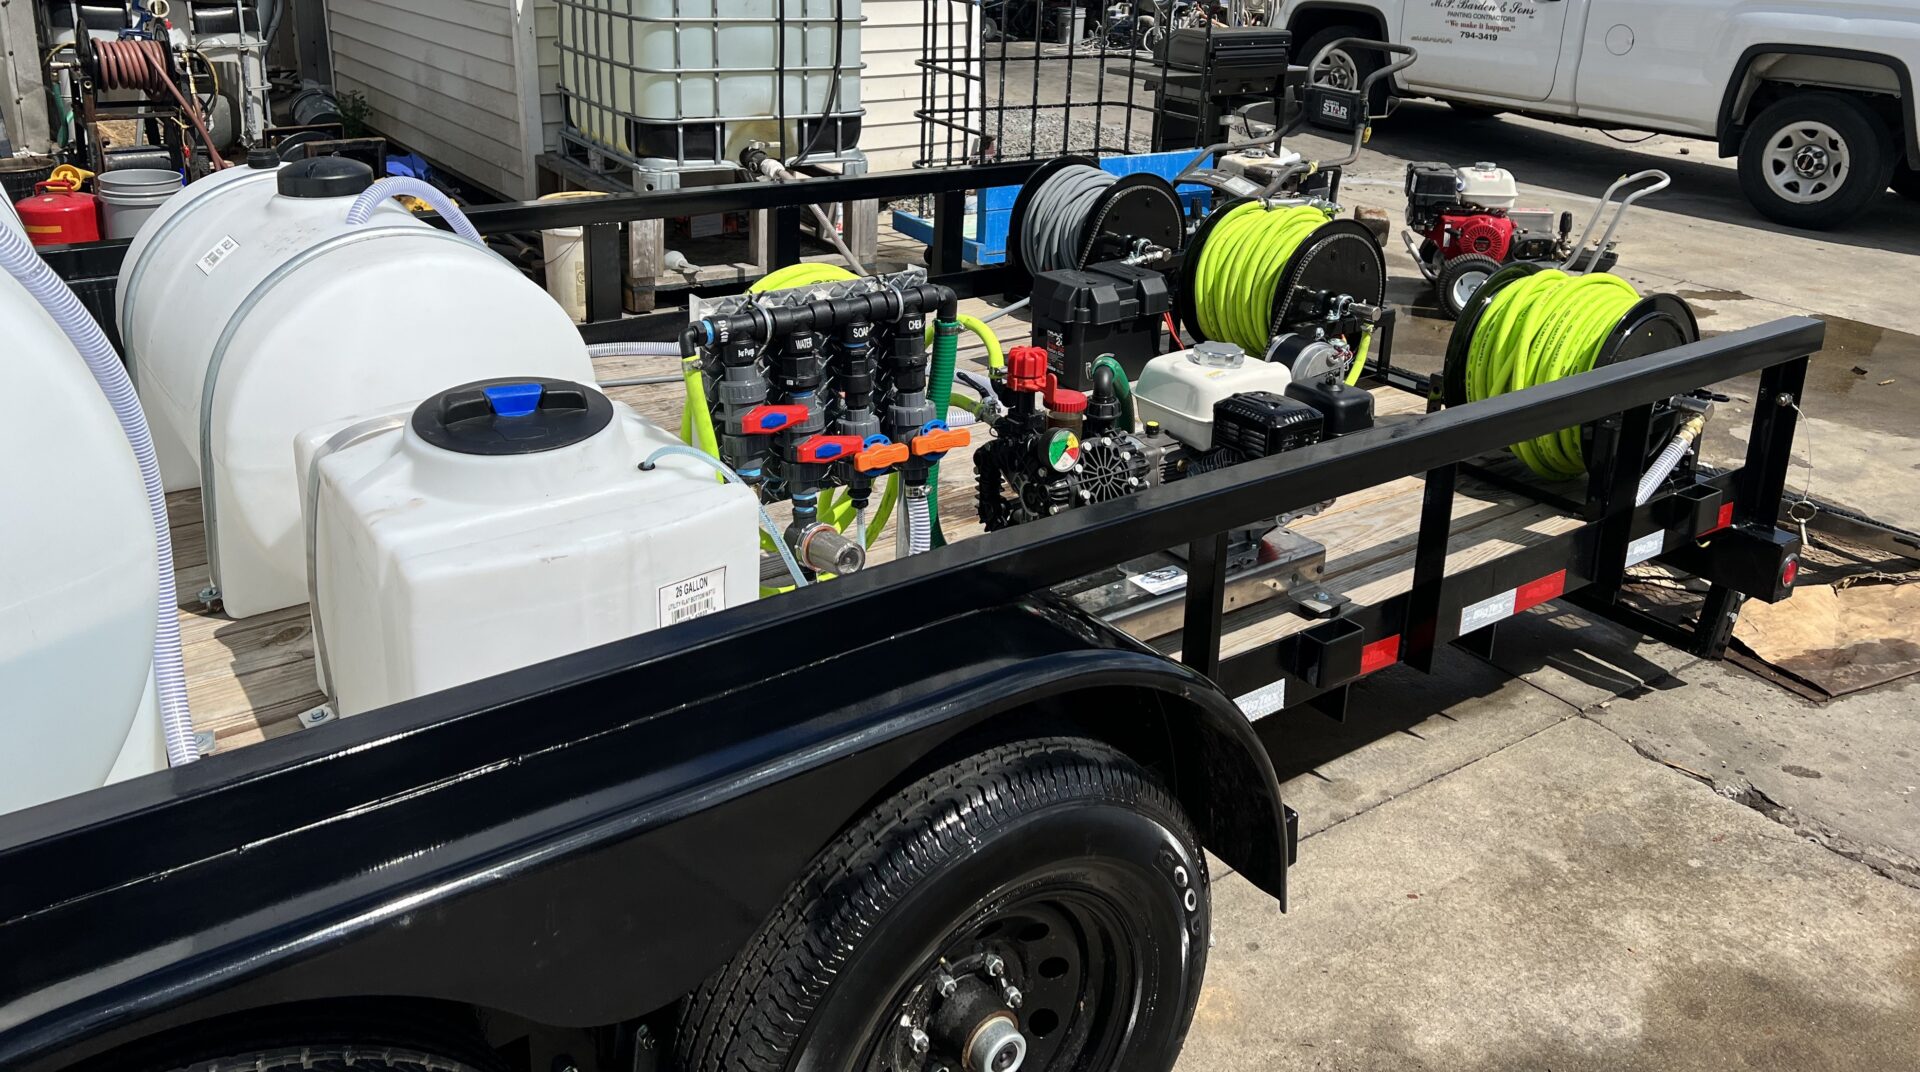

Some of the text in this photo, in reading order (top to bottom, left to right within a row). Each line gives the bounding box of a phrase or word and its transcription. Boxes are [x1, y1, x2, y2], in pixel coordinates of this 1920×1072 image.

[1457, 0, 1496, 11] Barden
[1500, 0, 1507, 13] &
[1509, 0, 1538, 15] Sons
[1447, 11, 1516, 22] PAINTING CONTRACTORS
[1460, 21, 1477, 29] make
[1460, 31, 1498, 41] 794-3419
[1323, 102, 1348, 117] STAR
[795, 337, 813, 349] WATER
[675, 585, 683, 598] 26
[683, 576, 708, 595] GALLON
